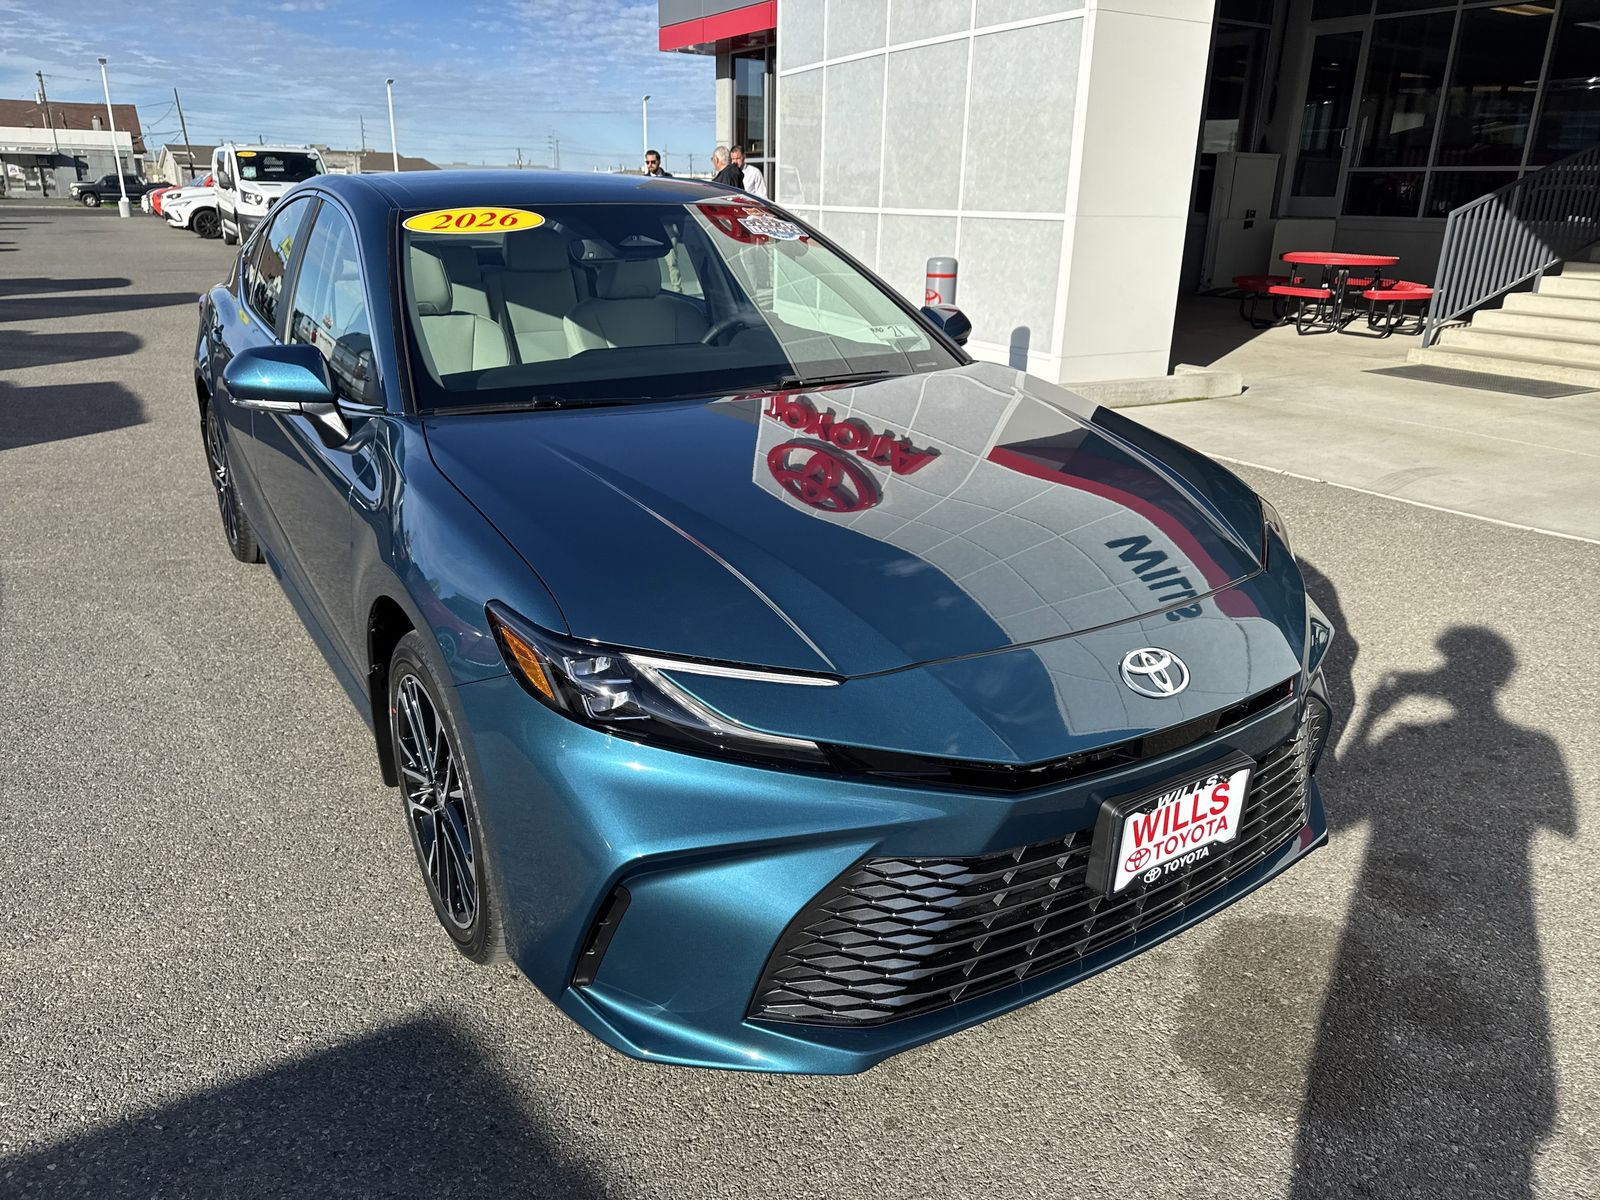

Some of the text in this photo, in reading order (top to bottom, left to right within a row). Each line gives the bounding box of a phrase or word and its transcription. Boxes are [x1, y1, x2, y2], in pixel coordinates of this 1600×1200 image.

[431, 212, 521, 230] 2026
[1157, 774, 1219, 807] WILLS
[1133, 783, 1230, 848] WILLS
[1153, 815, 1228, 860] TOYOTA
[1163, 847, 1209, 875] TOYOTA
